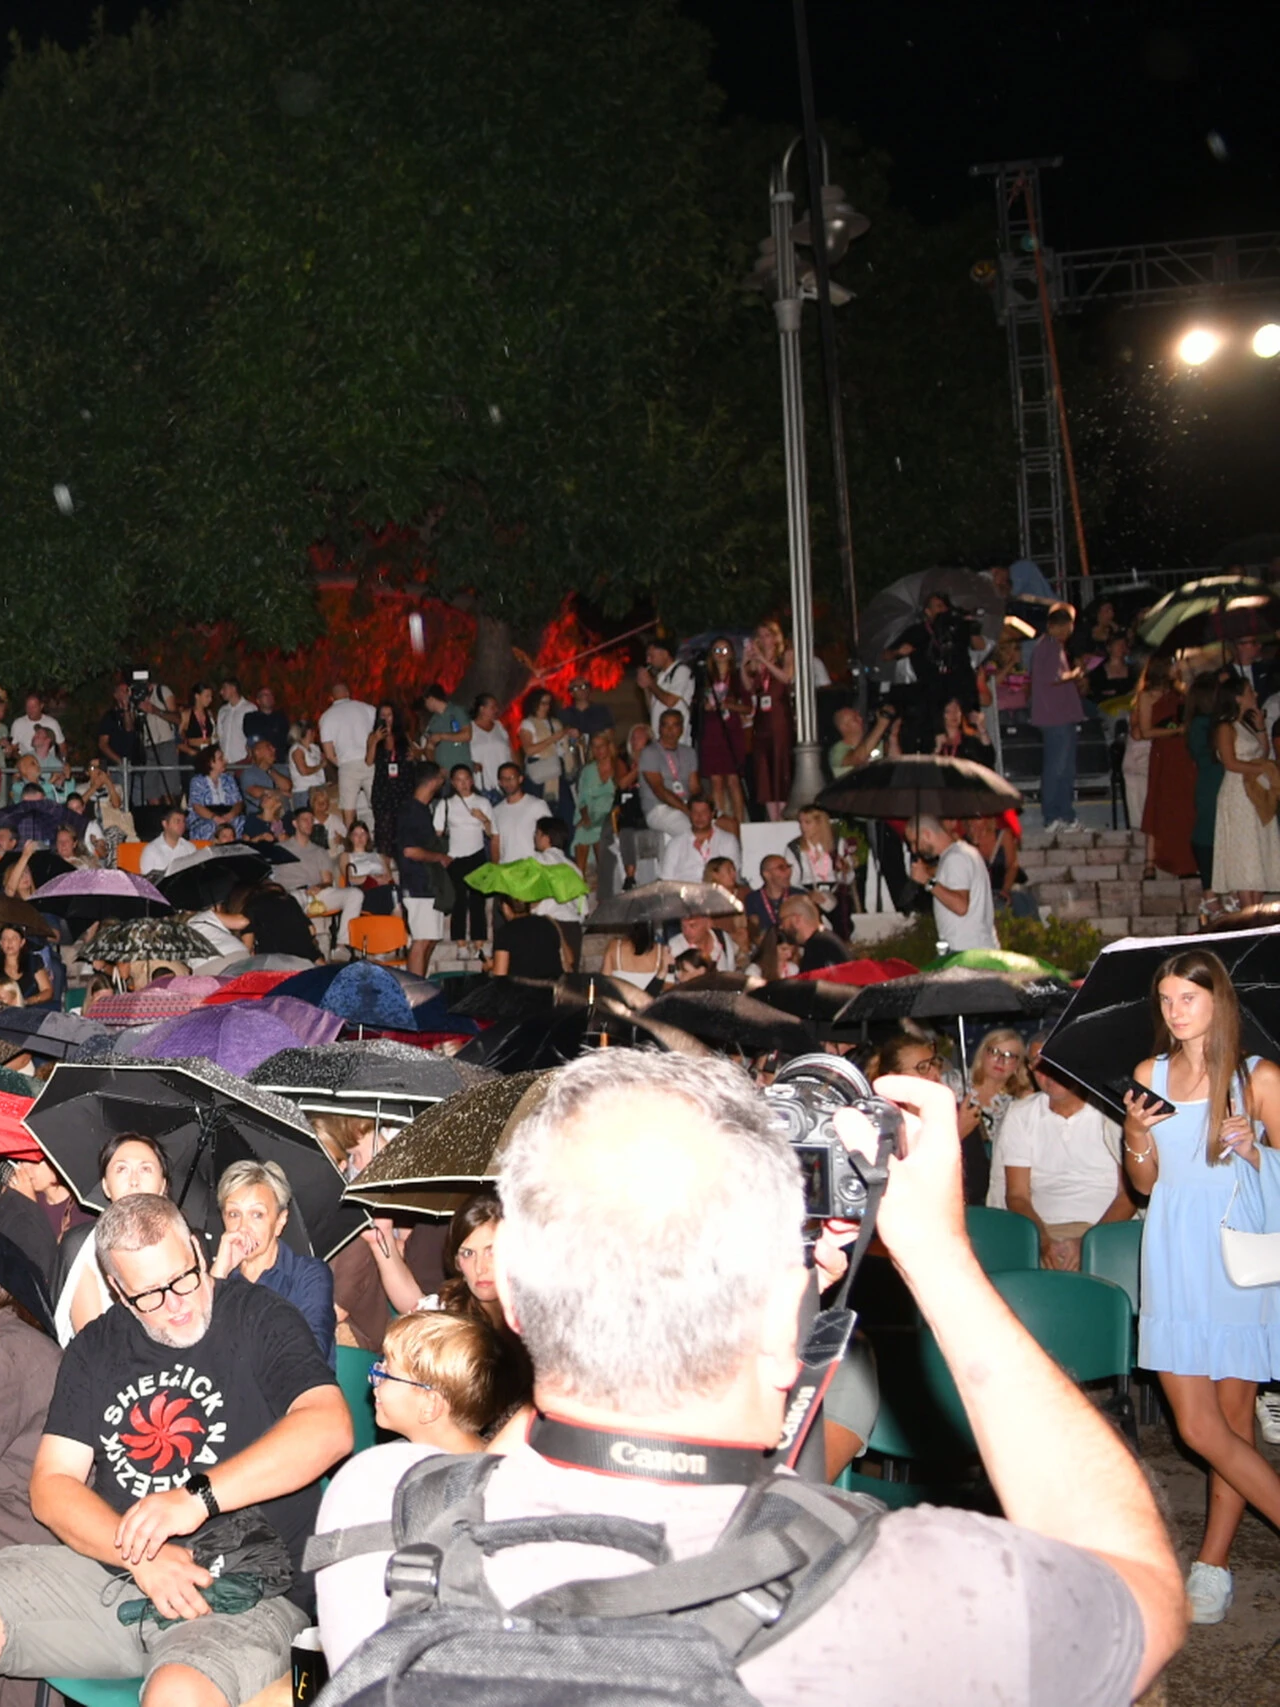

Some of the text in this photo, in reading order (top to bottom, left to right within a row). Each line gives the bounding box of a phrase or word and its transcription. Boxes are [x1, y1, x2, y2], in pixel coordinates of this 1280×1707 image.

[776, 1384, 816, 1450] Canon
[193, 1421, 227, 1464] NA
[609, 1441, 707, 1475] Canon
